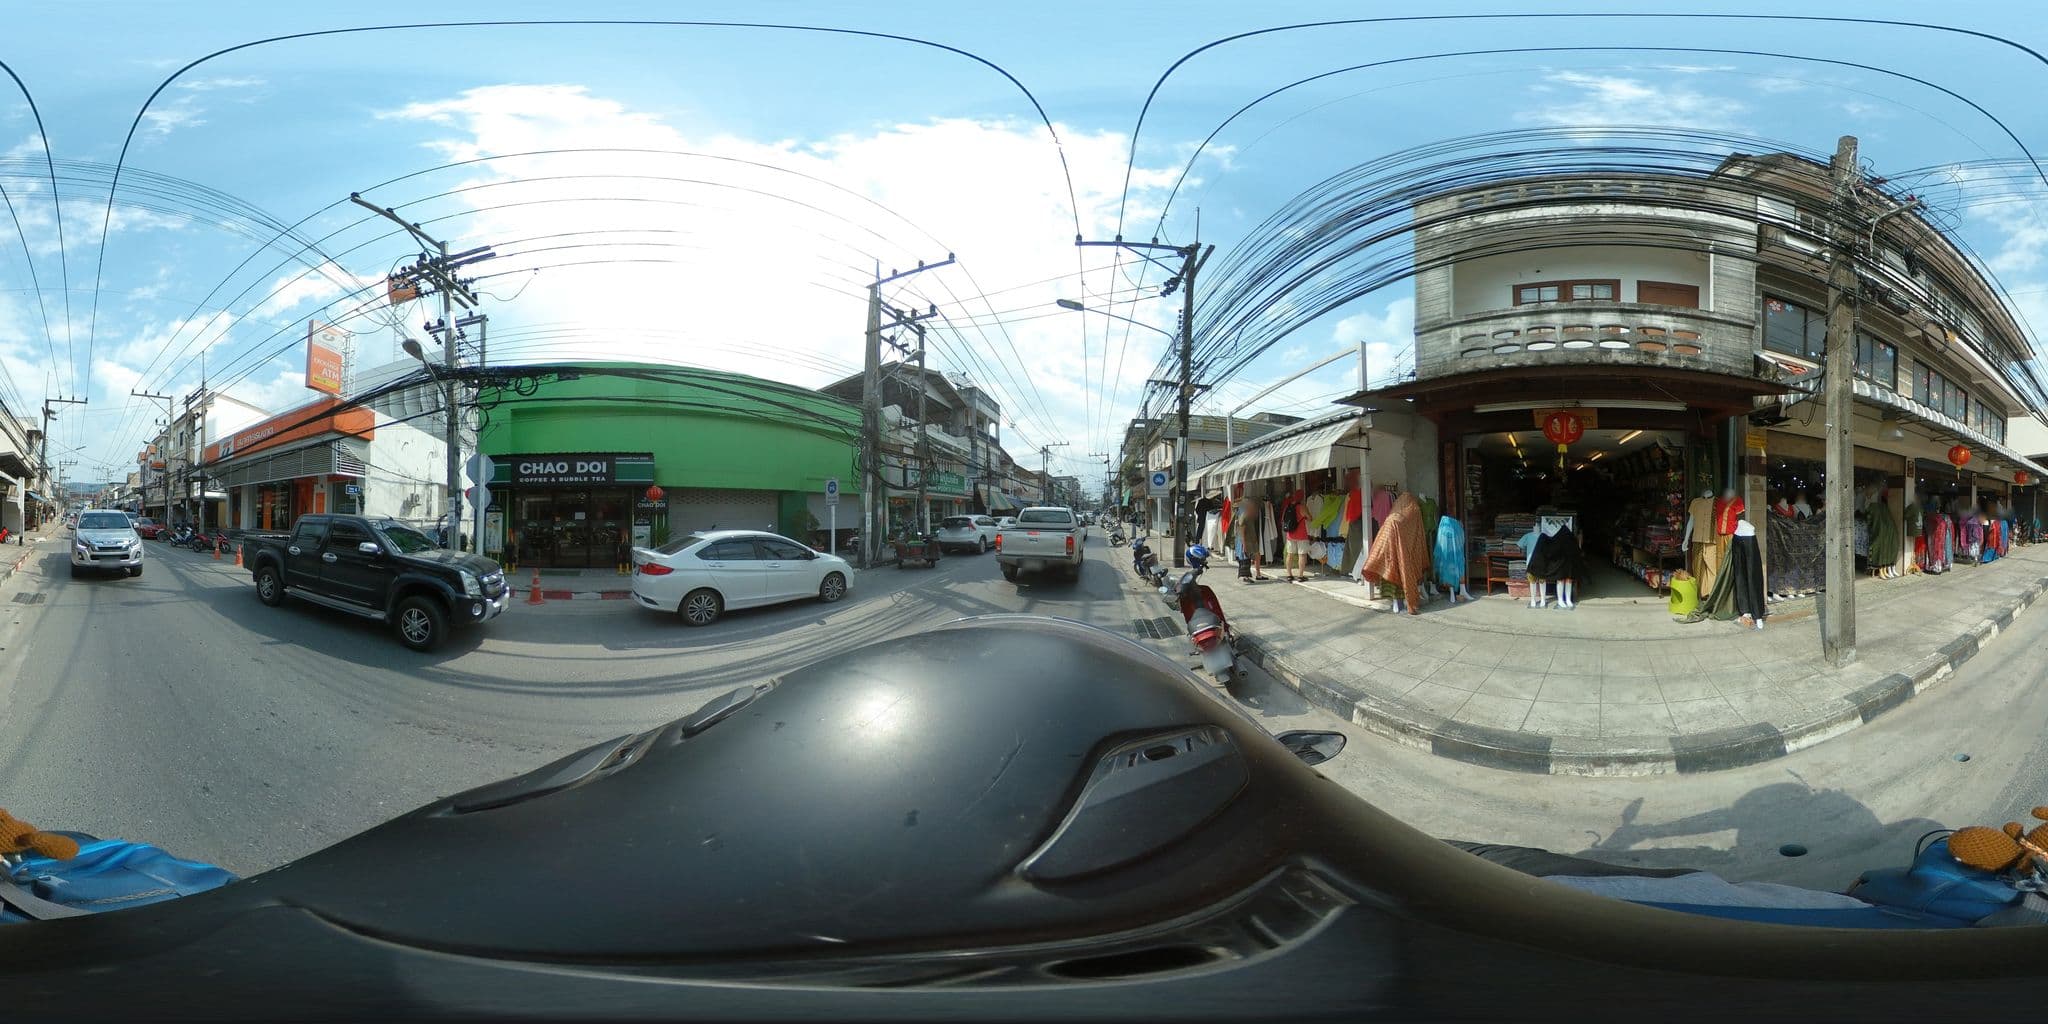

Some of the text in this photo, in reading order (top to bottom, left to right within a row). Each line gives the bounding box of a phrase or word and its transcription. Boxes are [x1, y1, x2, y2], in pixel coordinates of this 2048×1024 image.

[321, 368, 339, 381] ATM
[519, 461, 607, 474] CHAO DOI
